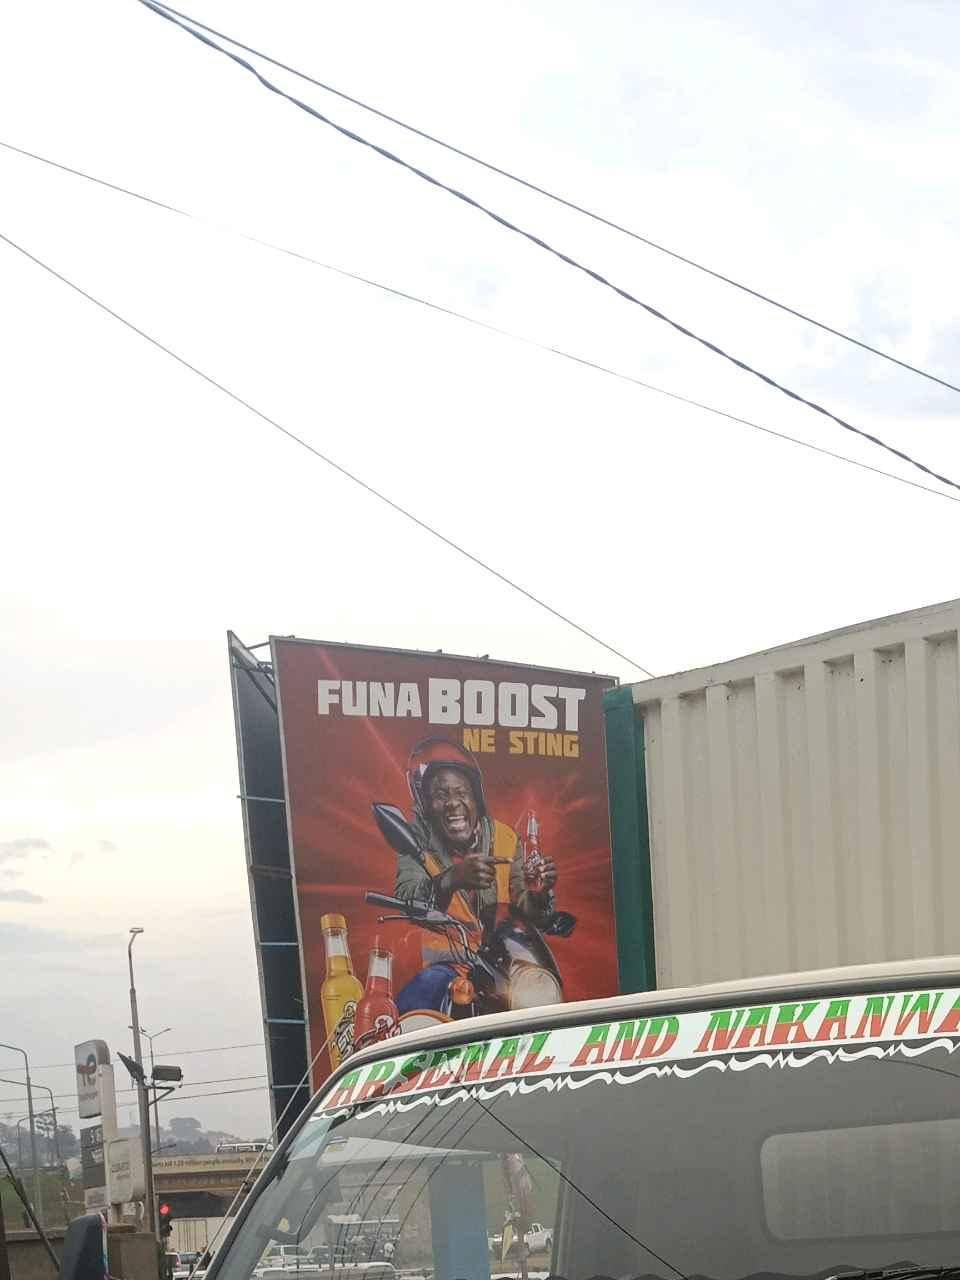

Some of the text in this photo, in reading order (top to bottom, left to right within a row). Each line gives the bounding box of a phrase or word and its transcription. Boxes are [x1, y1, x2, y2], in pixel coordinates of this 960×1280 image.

[317, 677, 587, 732] FUNA BOOST
[463, 728, 580, 758] NE STING
[322, 1031, 557, 1111] ARSENAL
[568, 1015, 681, 1068] AND
